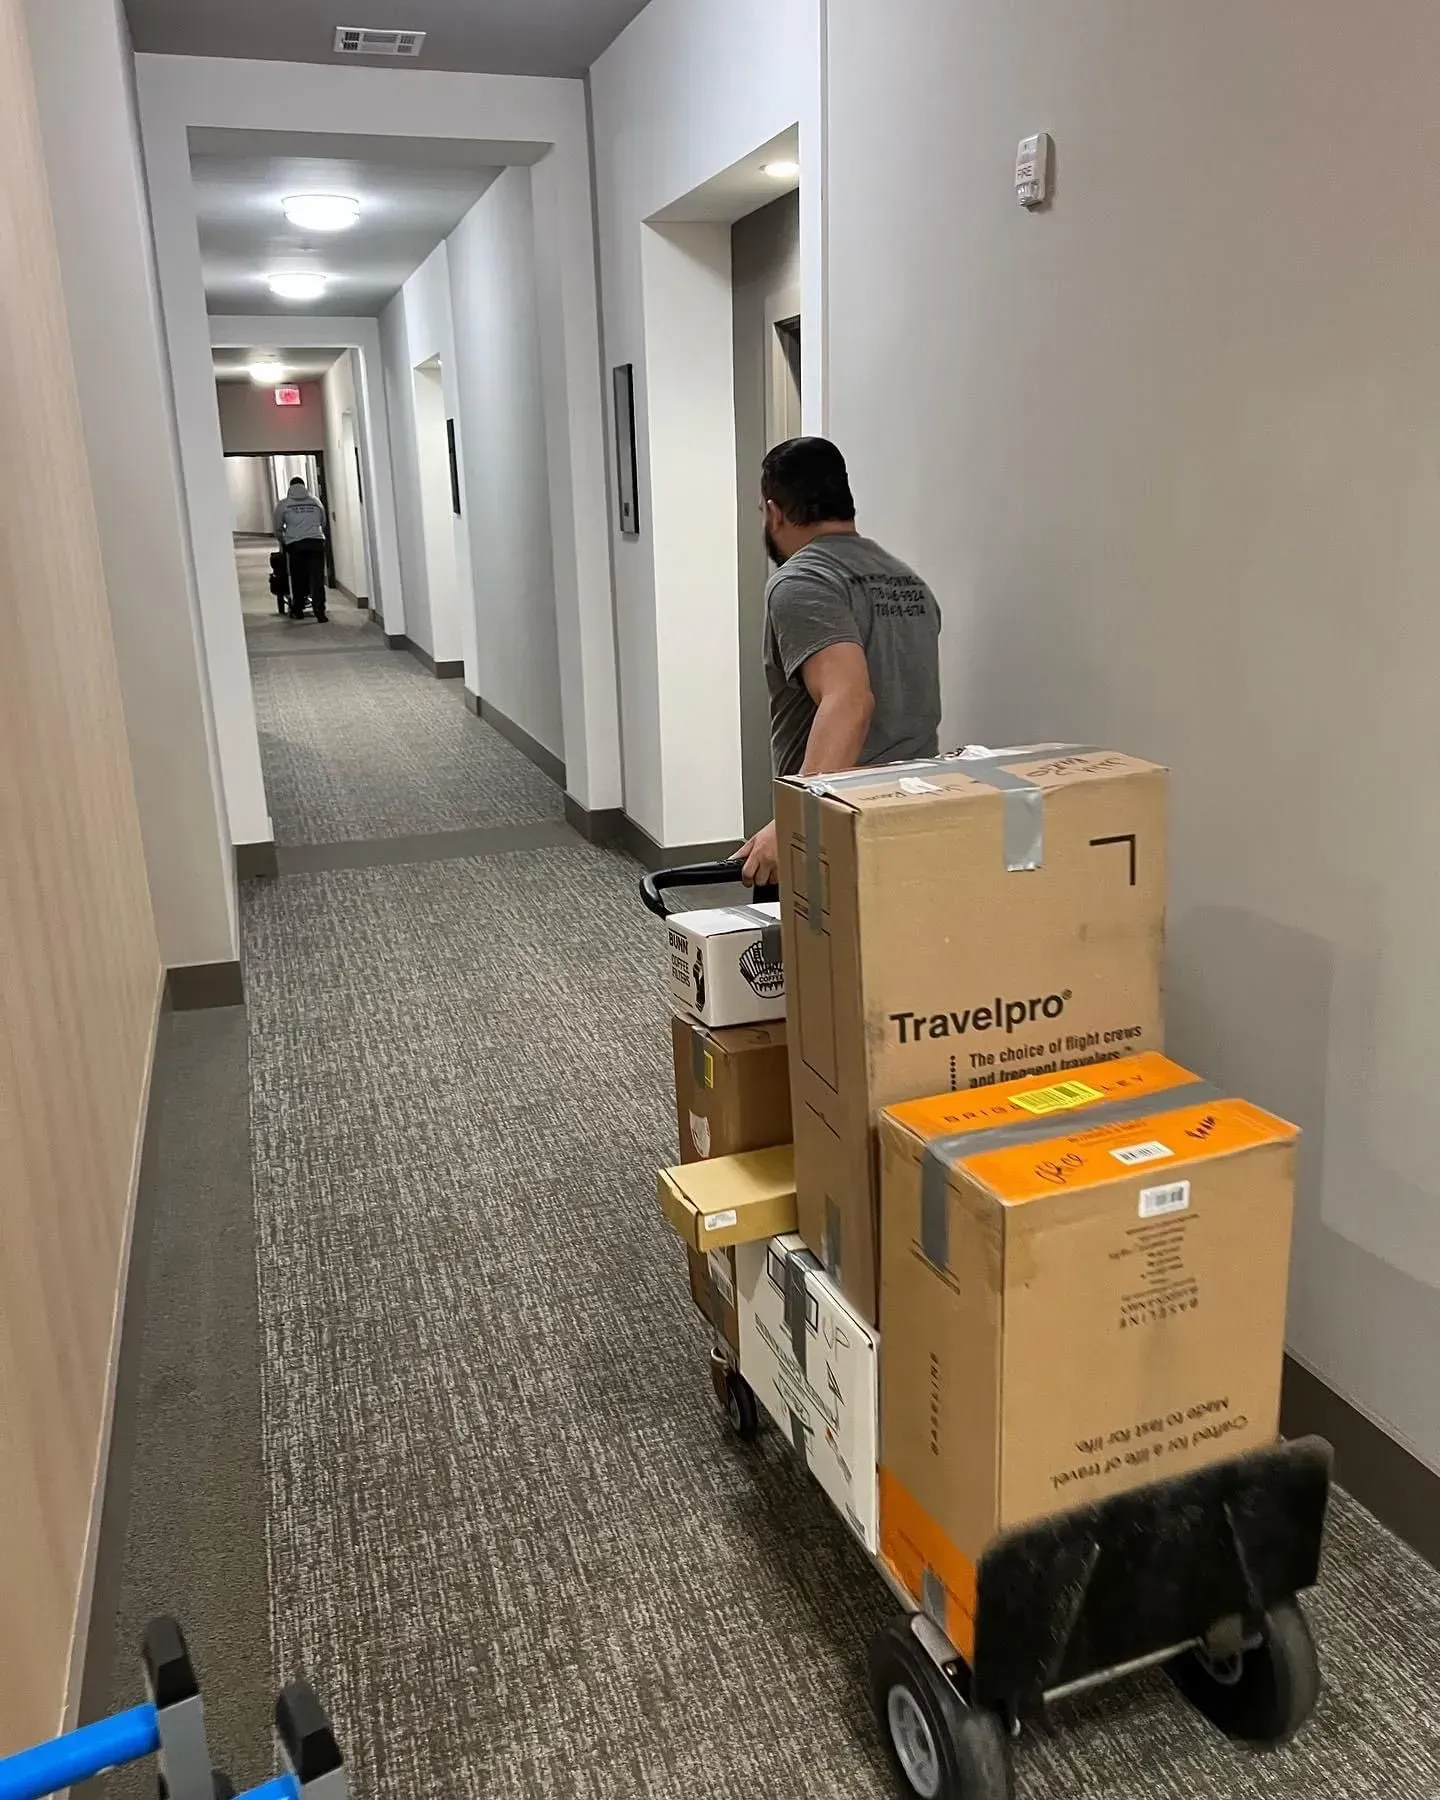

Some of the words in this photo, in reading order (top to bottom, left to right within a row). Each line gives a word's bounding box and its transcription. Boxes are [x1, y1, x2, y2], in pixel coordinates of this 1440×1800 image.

[668, 931, 689, 955] BUNN
[671, 953, 690, 975] COFFEE
[671, 966, 691, 987] FILTERS
[969, 1053, 995, 1069] The
[999, 1044, 1045, 1063] choice
[1048, 1038, 1063, 1055] of
[1065, 1031, 1102, 1051] flight
[1103, 1025, 1143, 1045] crews
[968, 1070, 996, 1089] and
[1186, 1396, 1230, 1420] Made
[1135, 1418, 1164, 1437] last
[1165, 1411, 1184, 1427] to
[1106, 1428, 1131, 1445] for
[1168, 1435, 1189, 1452] for
[1152, 1443, 1164, 1457] a
[1104, 1456, 1121, 1474] of
